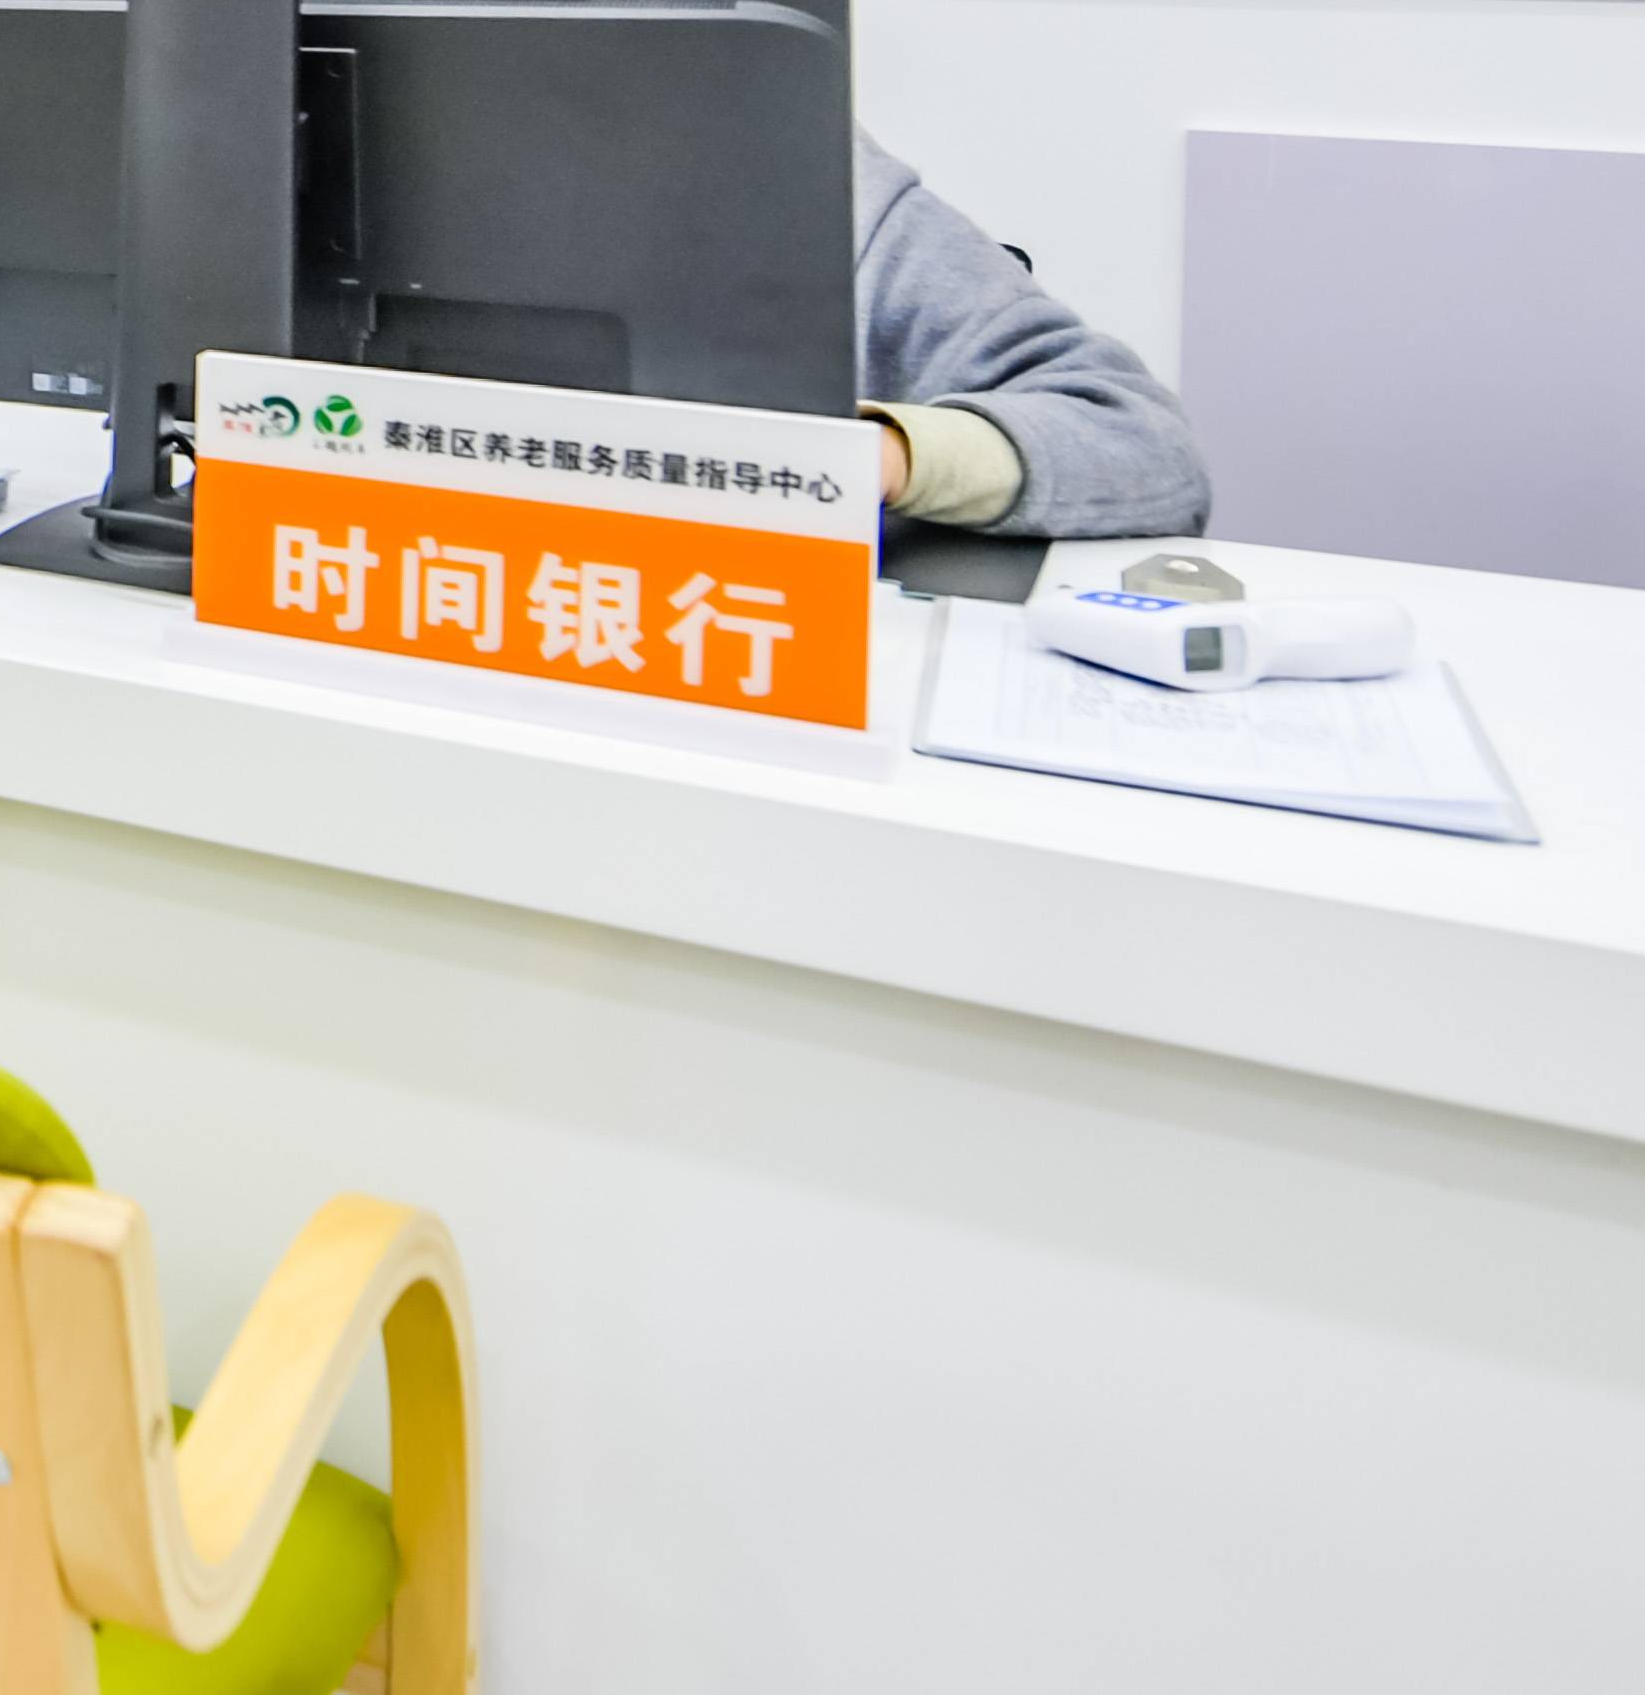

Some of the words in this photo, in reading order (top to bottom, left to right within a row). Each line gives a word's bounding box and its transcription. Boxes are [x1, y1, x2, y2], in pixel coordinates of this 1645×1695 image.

[383, 418, 844, 505] 秦淮区养老服务质量指导中心
[271, 523, 795, 699] 时间银行
